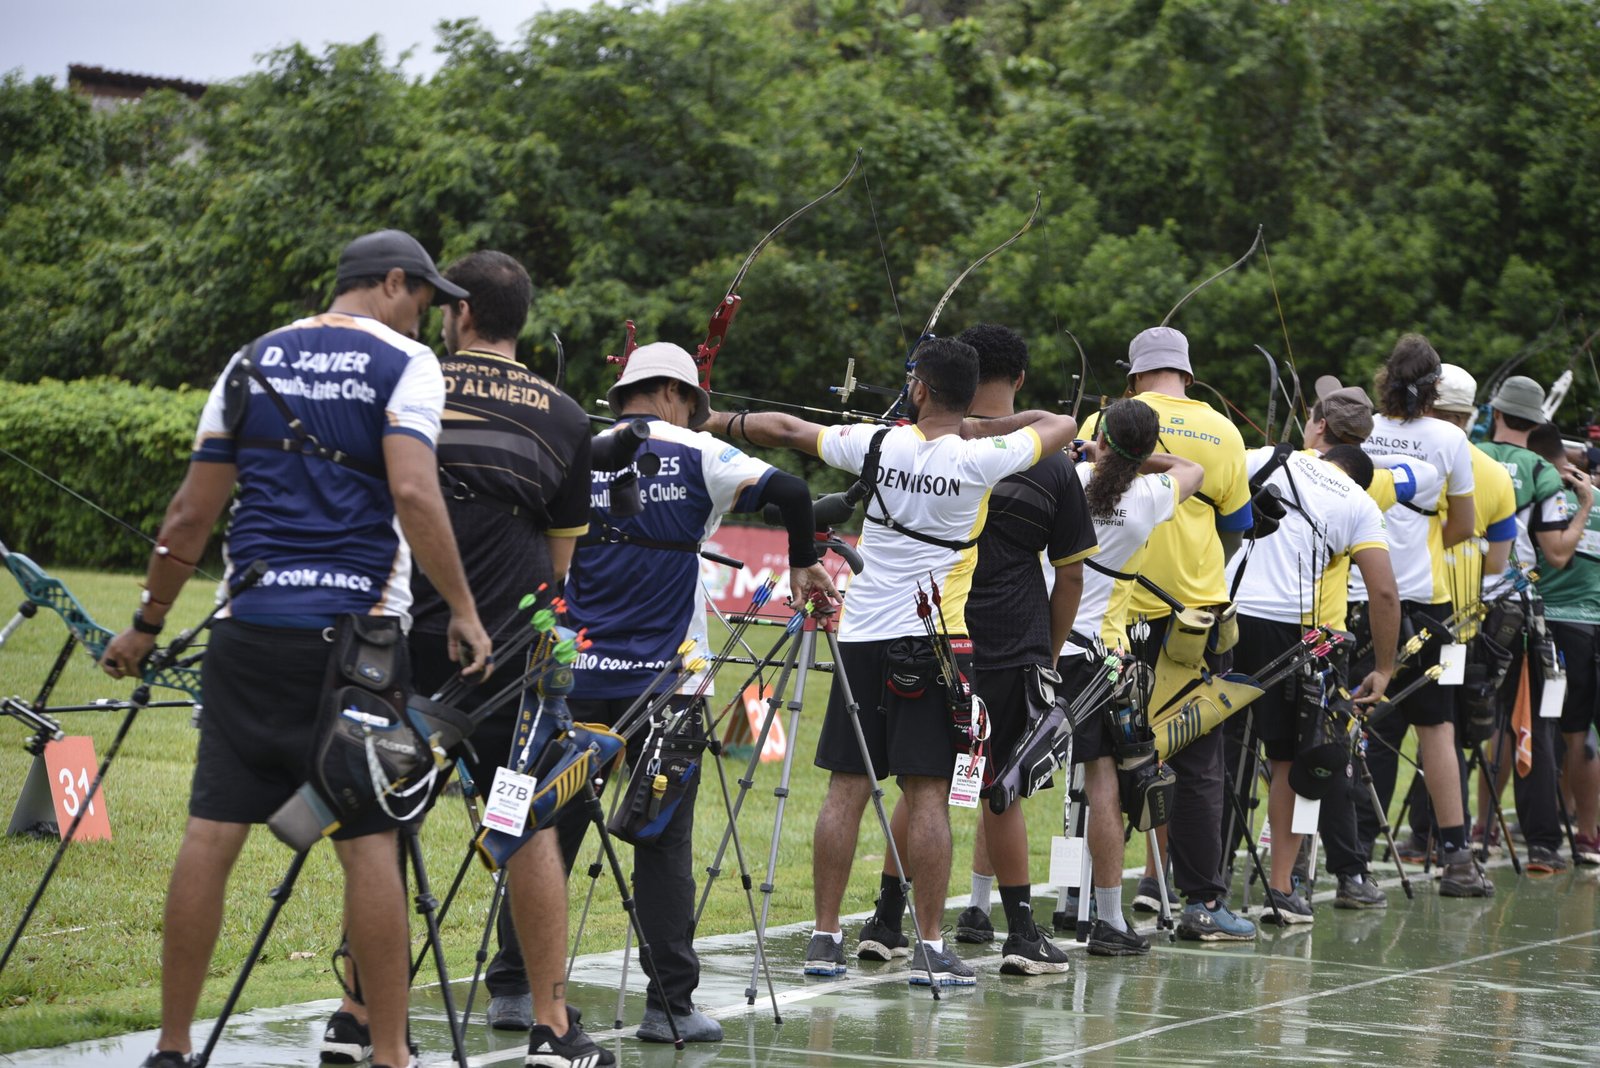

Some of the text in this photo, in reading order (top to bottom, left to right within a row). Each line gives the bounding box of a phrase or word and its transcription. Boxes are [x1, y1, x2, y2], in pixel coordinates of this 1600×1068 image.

[259, 346, 371, 374] D. XAVIER
[441, 361, 501, 377] ISPARA
[1158, 426, 1221, 446] ORTOLOTO
[1366, 436, 1423, 451] ARLOS V.
[649, 481, 687, 502] Clube
[277, 568, 319, 587] COM
[956, 763, 980, 779] 29A
[59, 767, 95, 817] 31
[496, 781, 529, 801] 27B
